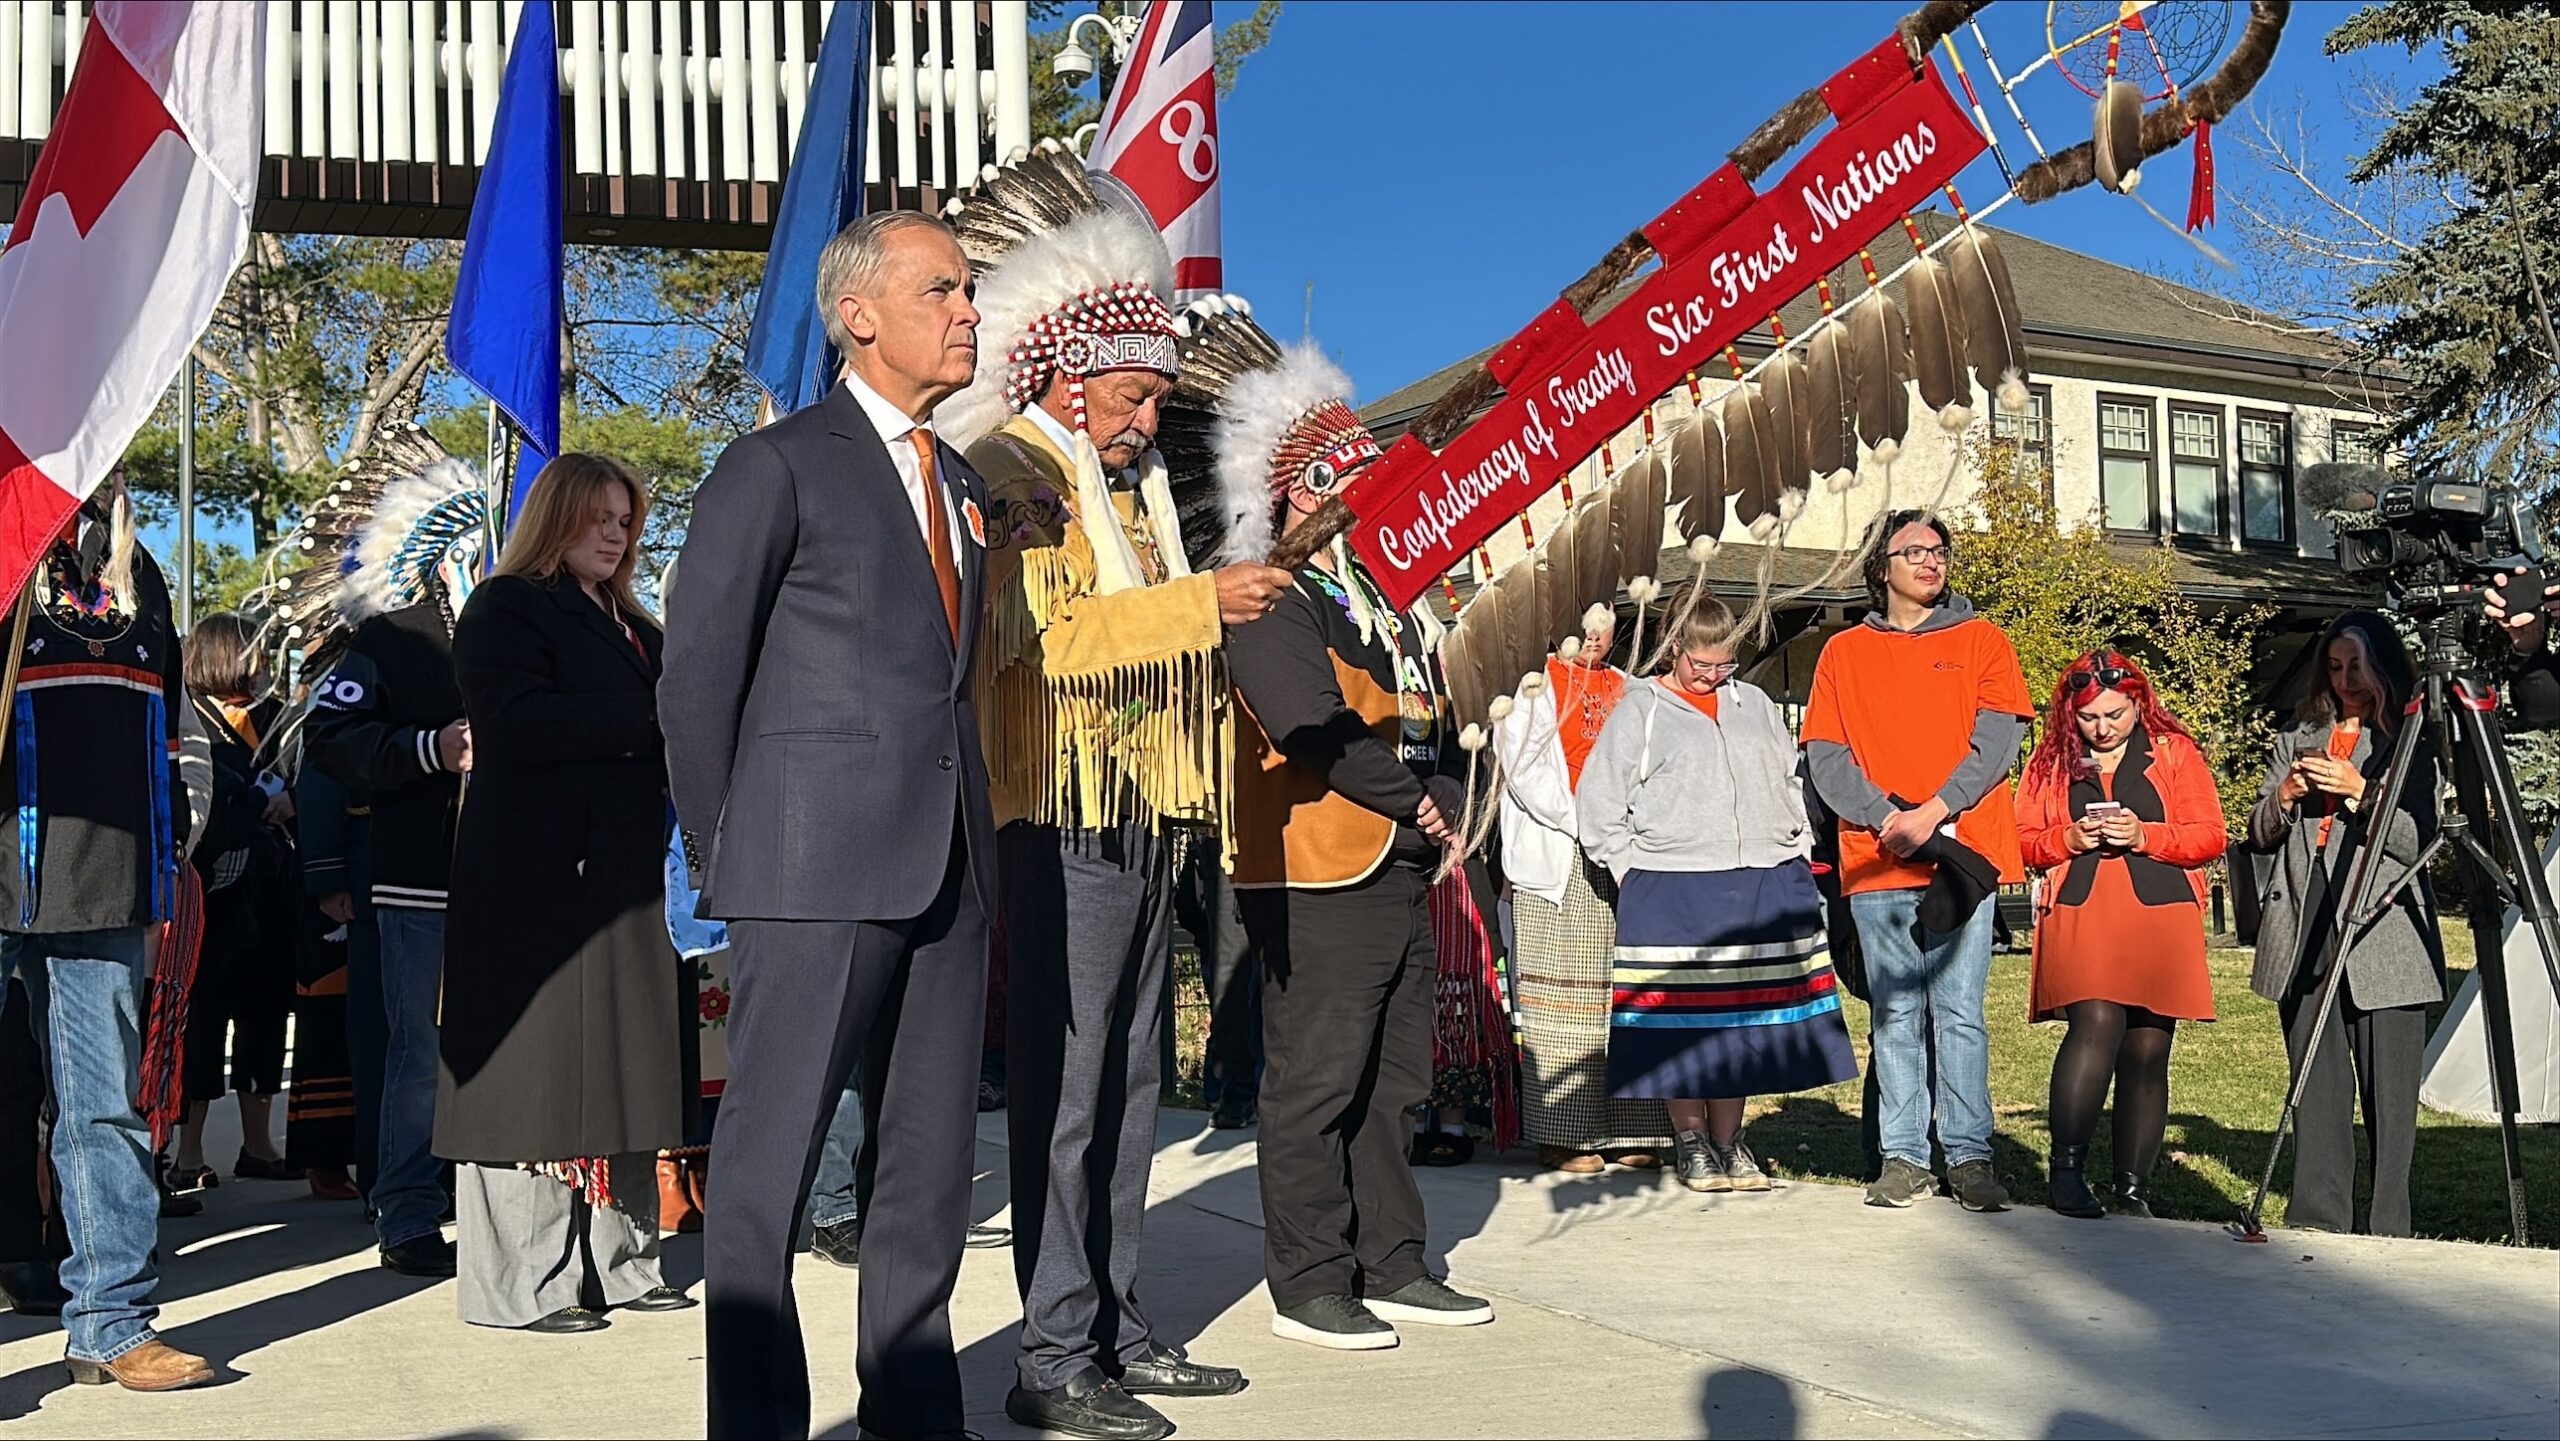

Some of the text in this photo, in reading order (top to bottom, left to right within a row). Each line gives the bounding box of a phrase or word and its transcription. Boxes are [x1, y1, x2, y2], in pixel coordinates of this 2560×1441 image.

[1377, 120, 1937, 572] Confederacy of Treaty Six First Nations
[1403, 744, 1428, 761] CREE
